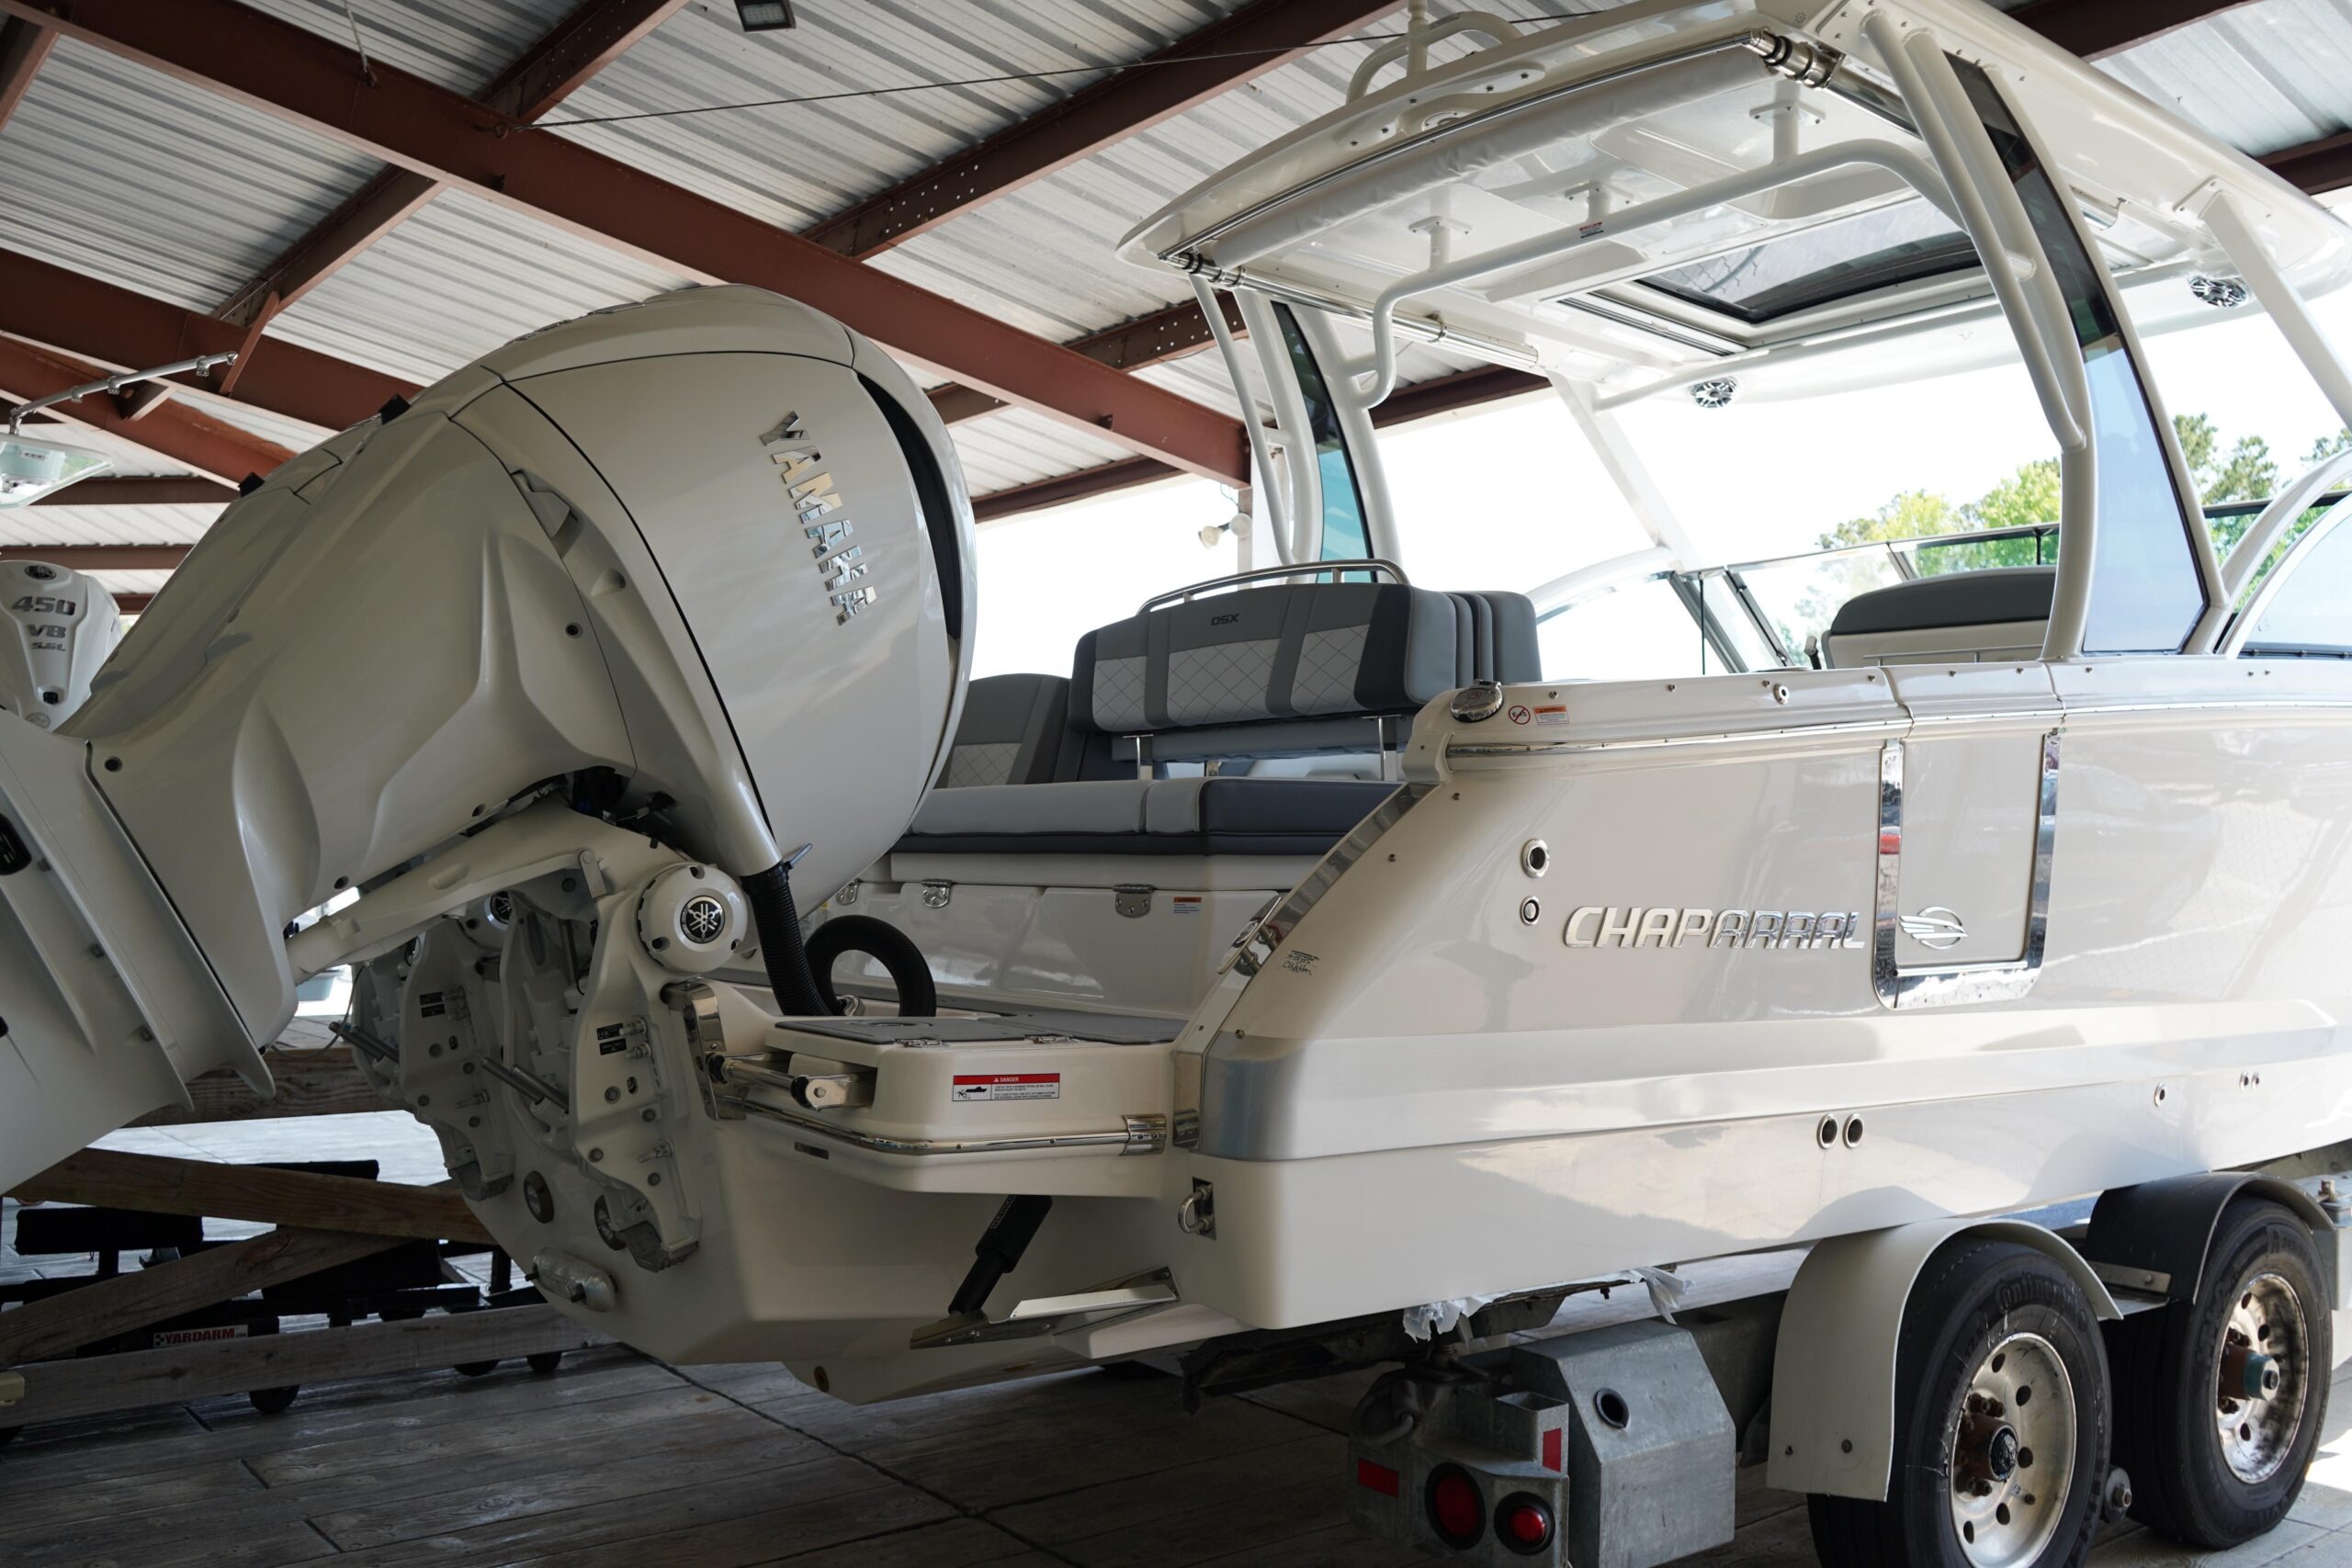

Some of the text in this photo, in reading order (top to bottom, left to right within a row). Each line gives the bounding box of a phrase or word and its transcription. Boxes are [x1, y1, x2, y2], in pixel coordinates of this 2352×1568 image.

[759, 411, 876, 626] YAMAHA
[11, 596, 76, 616] 450
[27, 624, 67, 638] V8
[31, 642, 66, 651] 5.6L
[1564, 906, 1866, 949] CHAPARRAL
[164, 1327, 235, 1344] YARDARM
